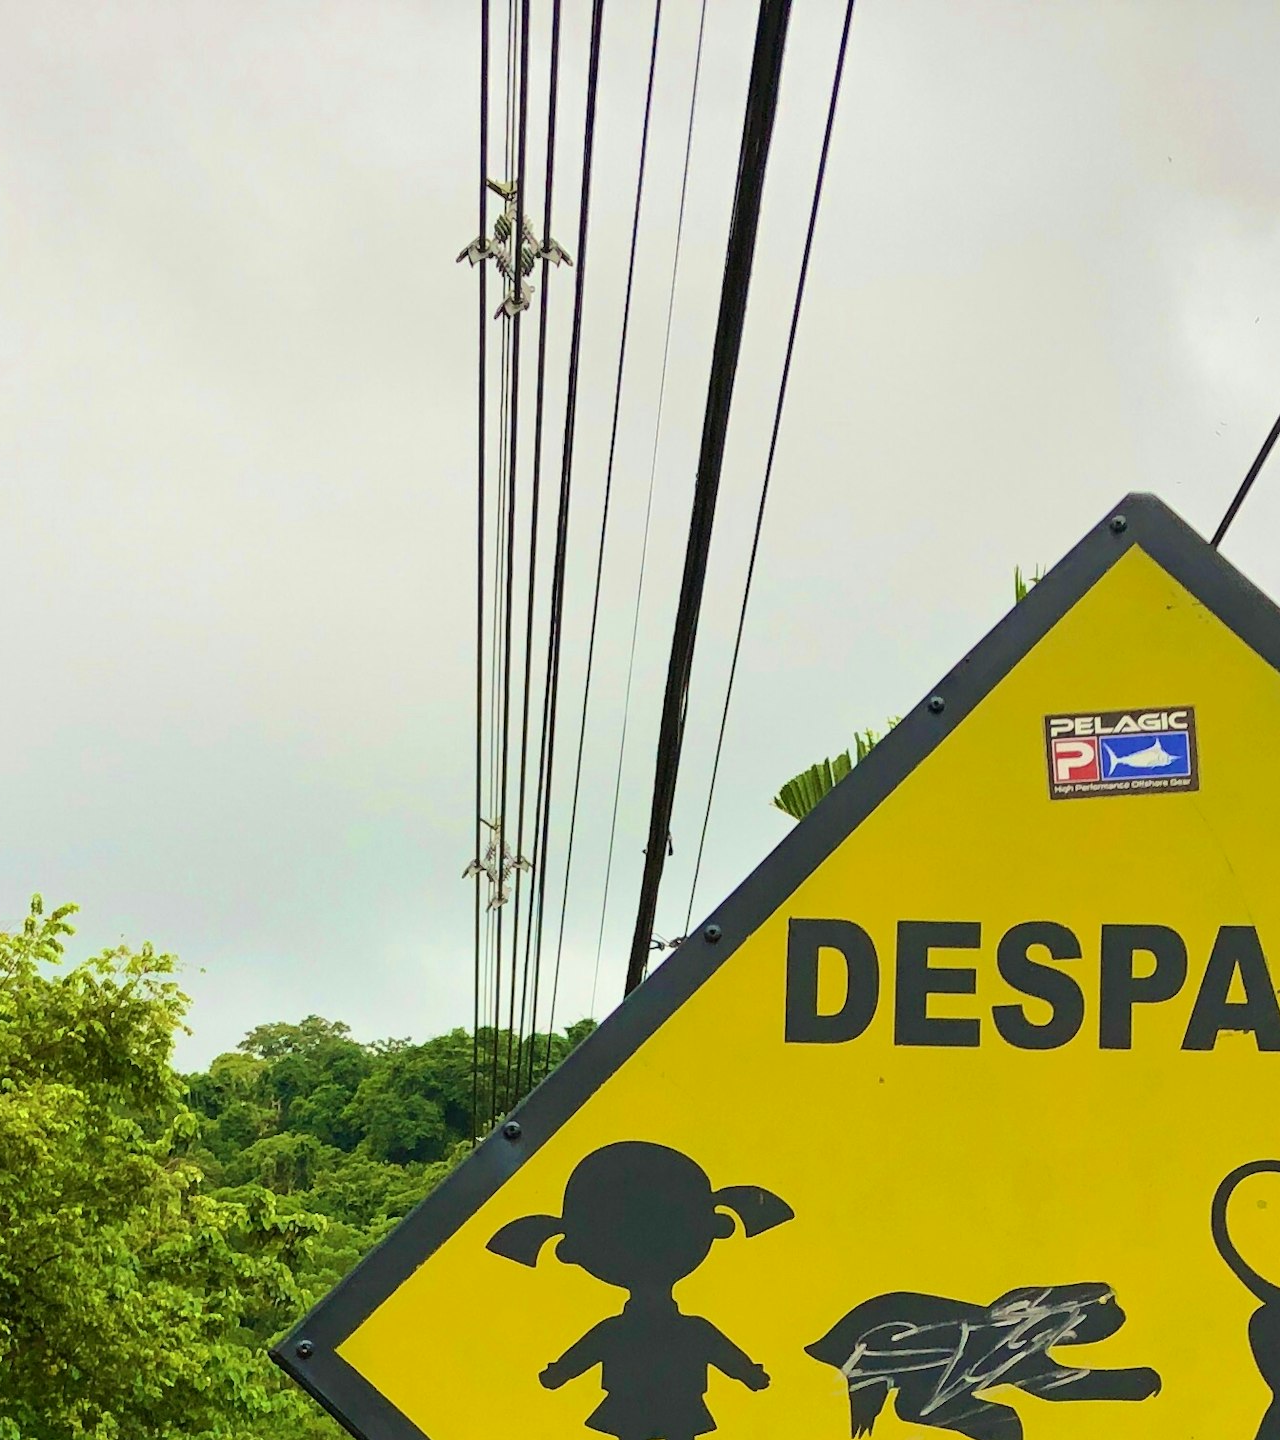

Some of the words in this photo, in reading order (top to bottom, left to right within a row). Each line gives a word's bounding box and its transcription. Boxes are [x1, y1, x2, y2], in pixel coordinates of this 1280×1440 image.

[1050, 711, 1188, 737] PELAGIC
[1056, 741, 1095, 780] P
[1054, 783, 1074, 794] High
[1075, 781, 1130, 792] Performance
[1131, 779, 1169, 789] Offshore
